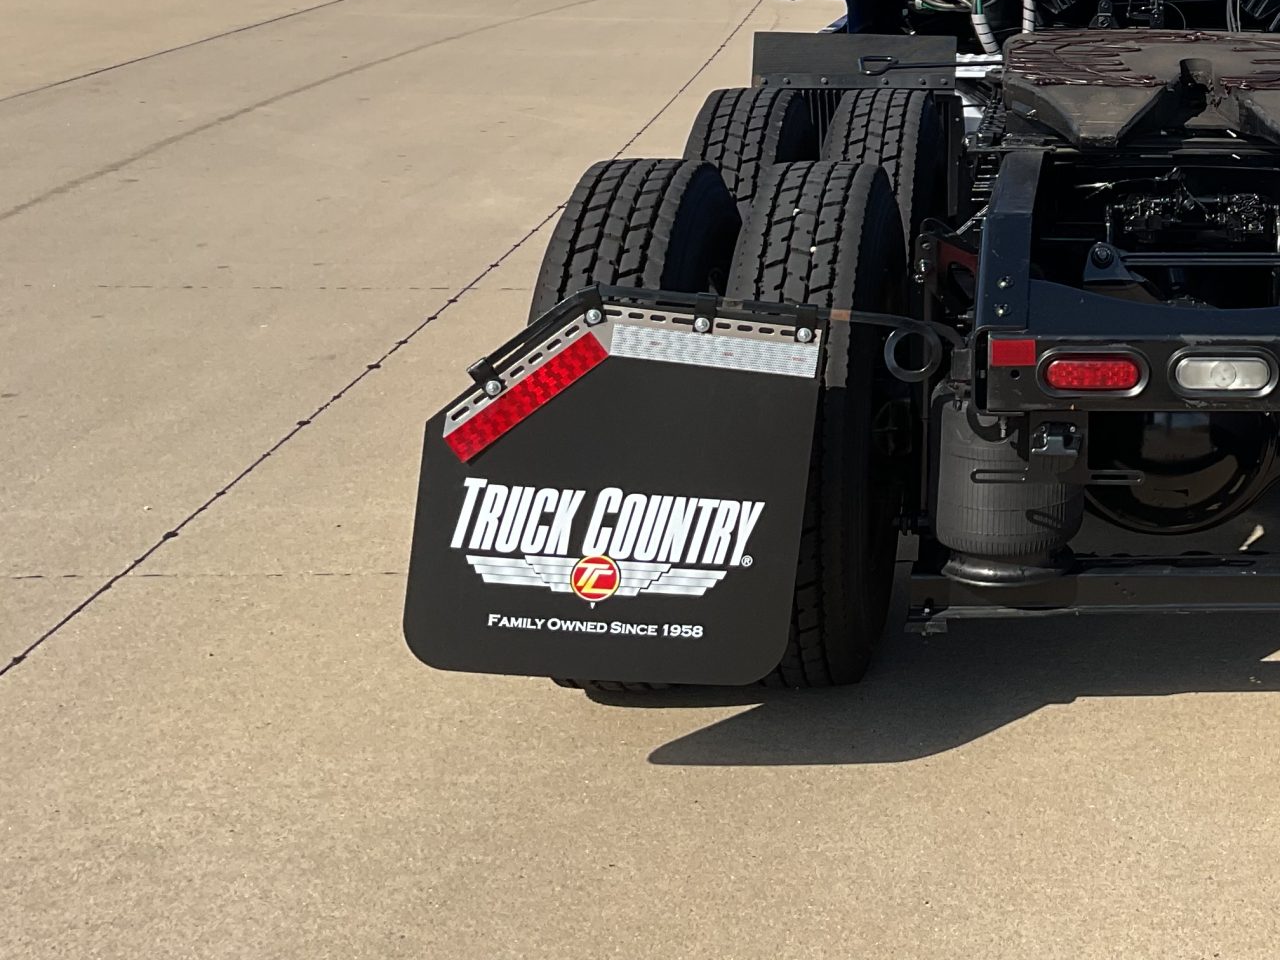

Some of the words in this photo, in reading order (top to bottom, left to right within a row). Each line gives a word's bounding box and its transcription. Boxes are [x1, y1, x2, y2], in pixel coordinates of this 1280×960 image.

[450, 477, 586, 555] TRUCK
[581, 487, 766, 567] COUNTRY
[487, 613, 546, 631] FAMILY
[546, 617, 608, 634] OWNED
[610, 620, 658, 636] SINCE
[661, 623, 704, 638] 1958
